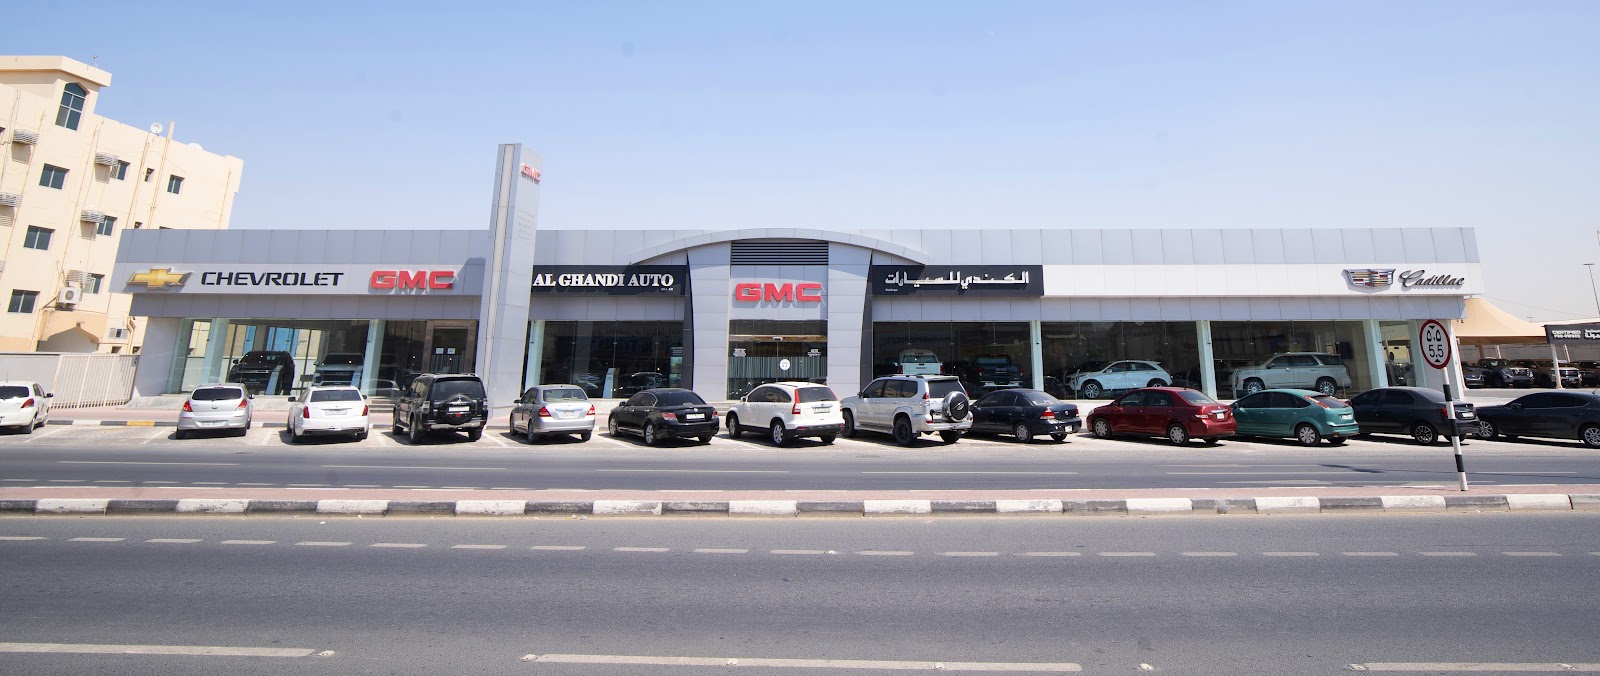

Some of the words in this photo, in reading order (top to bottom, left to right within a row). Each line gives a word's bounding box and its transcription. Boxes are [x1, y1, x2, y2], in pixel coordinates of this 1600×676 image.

[521, 164, 542, 182] GMC
[201, 272, 344, 286] CHEVROLET
[370, 270, 454, 289] GMC
[533, 273, 556, 287] AL
[558, 273, 625, 287] GHANDI
[628, 273, 674, 287] AUTO
[885, 271, 960, 287] للسيارات
[1399, 269, 1465, 288] Cadillac
[735, 283, 823, 302] GMC
[1428, 344, 1444, 358] 5.5
